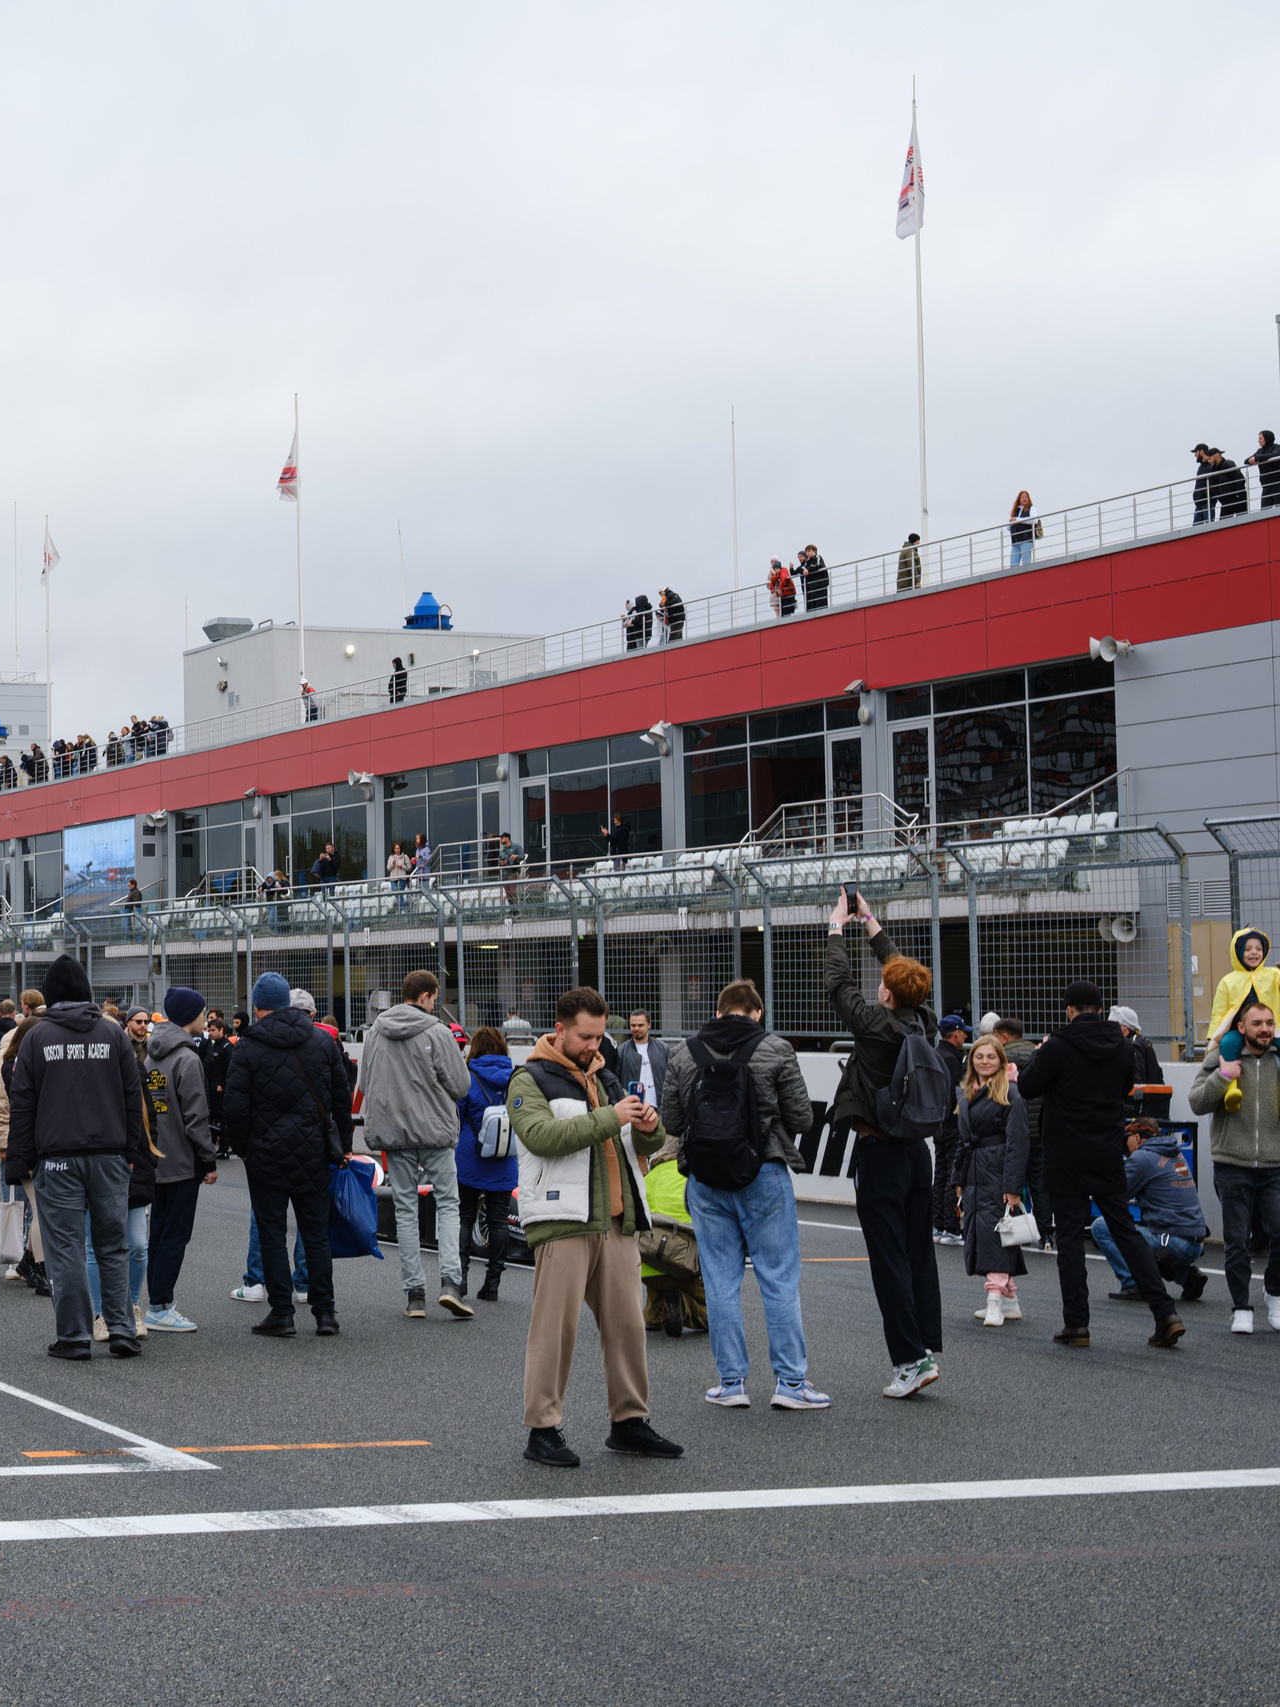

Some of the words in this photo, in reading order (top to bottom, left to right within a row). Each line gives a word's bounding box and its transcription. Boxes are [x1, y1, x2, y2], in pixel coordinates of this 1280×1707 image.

[43, 1044, 64, 1062] MOSCOW
[67, 1044, 85, 1059] SPORTS
[88, 1043, 111, 1059] ACADEMY
